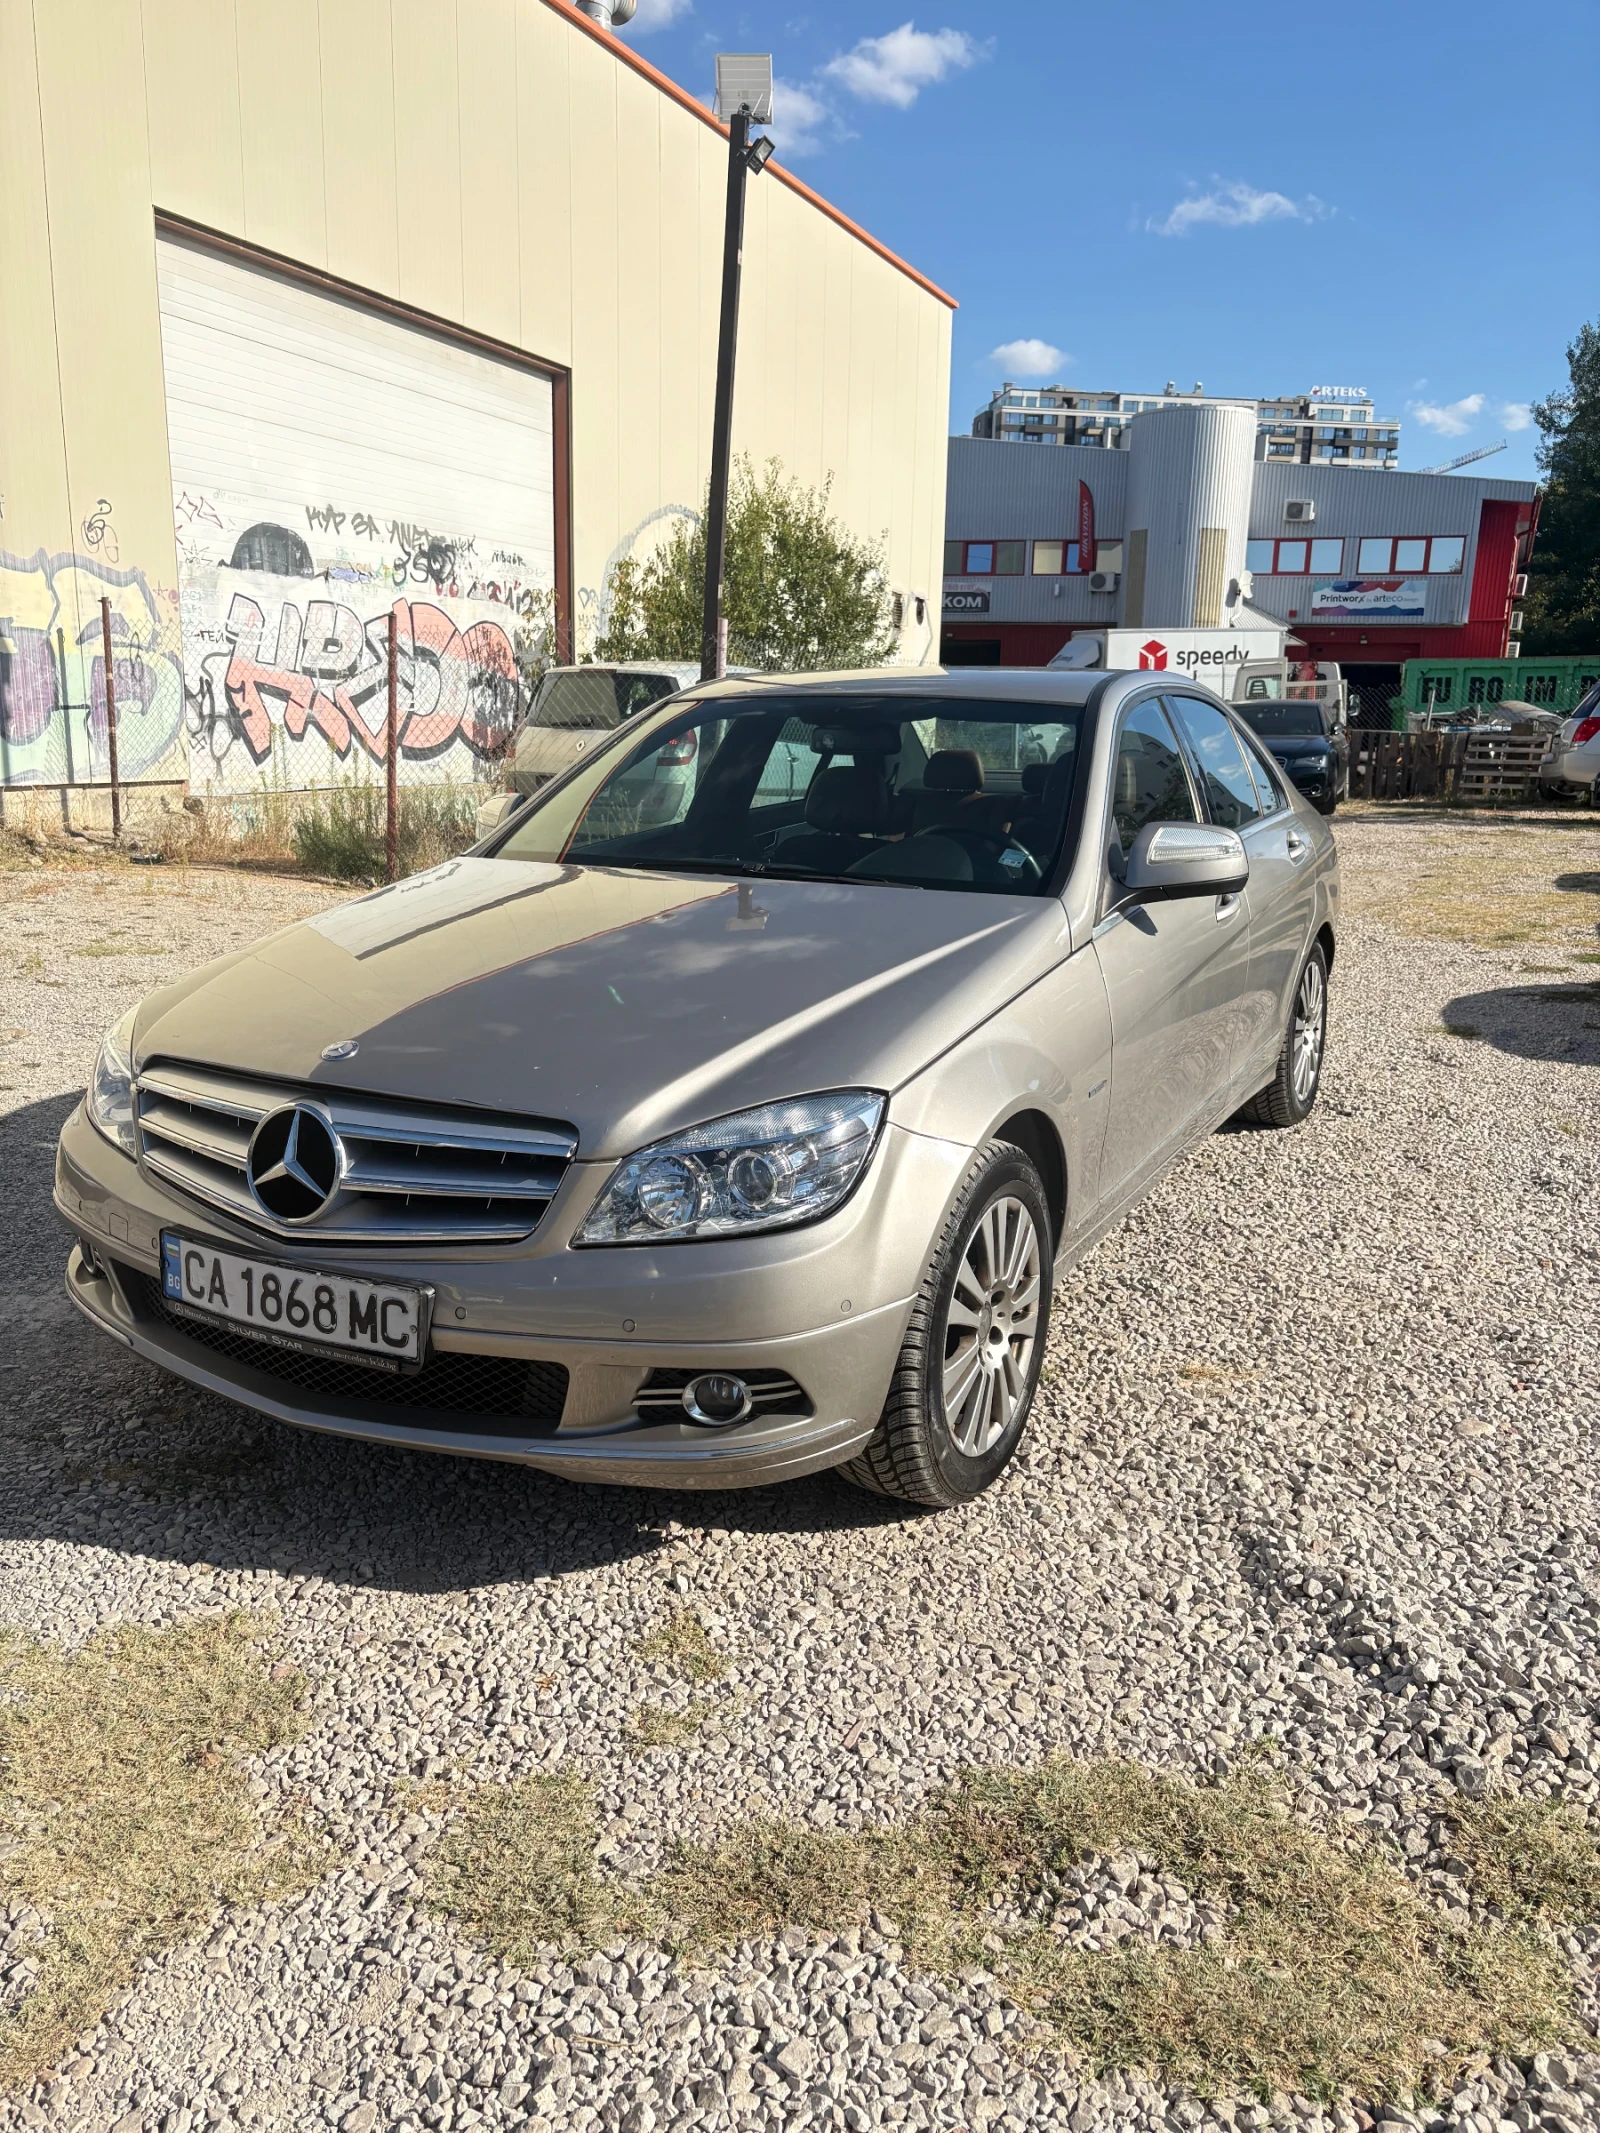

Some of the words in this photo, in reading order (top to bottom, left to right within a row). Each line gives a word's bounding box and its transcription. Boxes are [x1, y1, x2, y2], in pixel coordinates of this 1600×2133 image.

[1309, 385, 1367, 397] ARTEKS
[168, 1273, 181, 1290] BG
[184, 1250, 229, 1309] CA
[240, 1266, 338, 1335] 1868
[348, 1290, 410, 1349] MC
